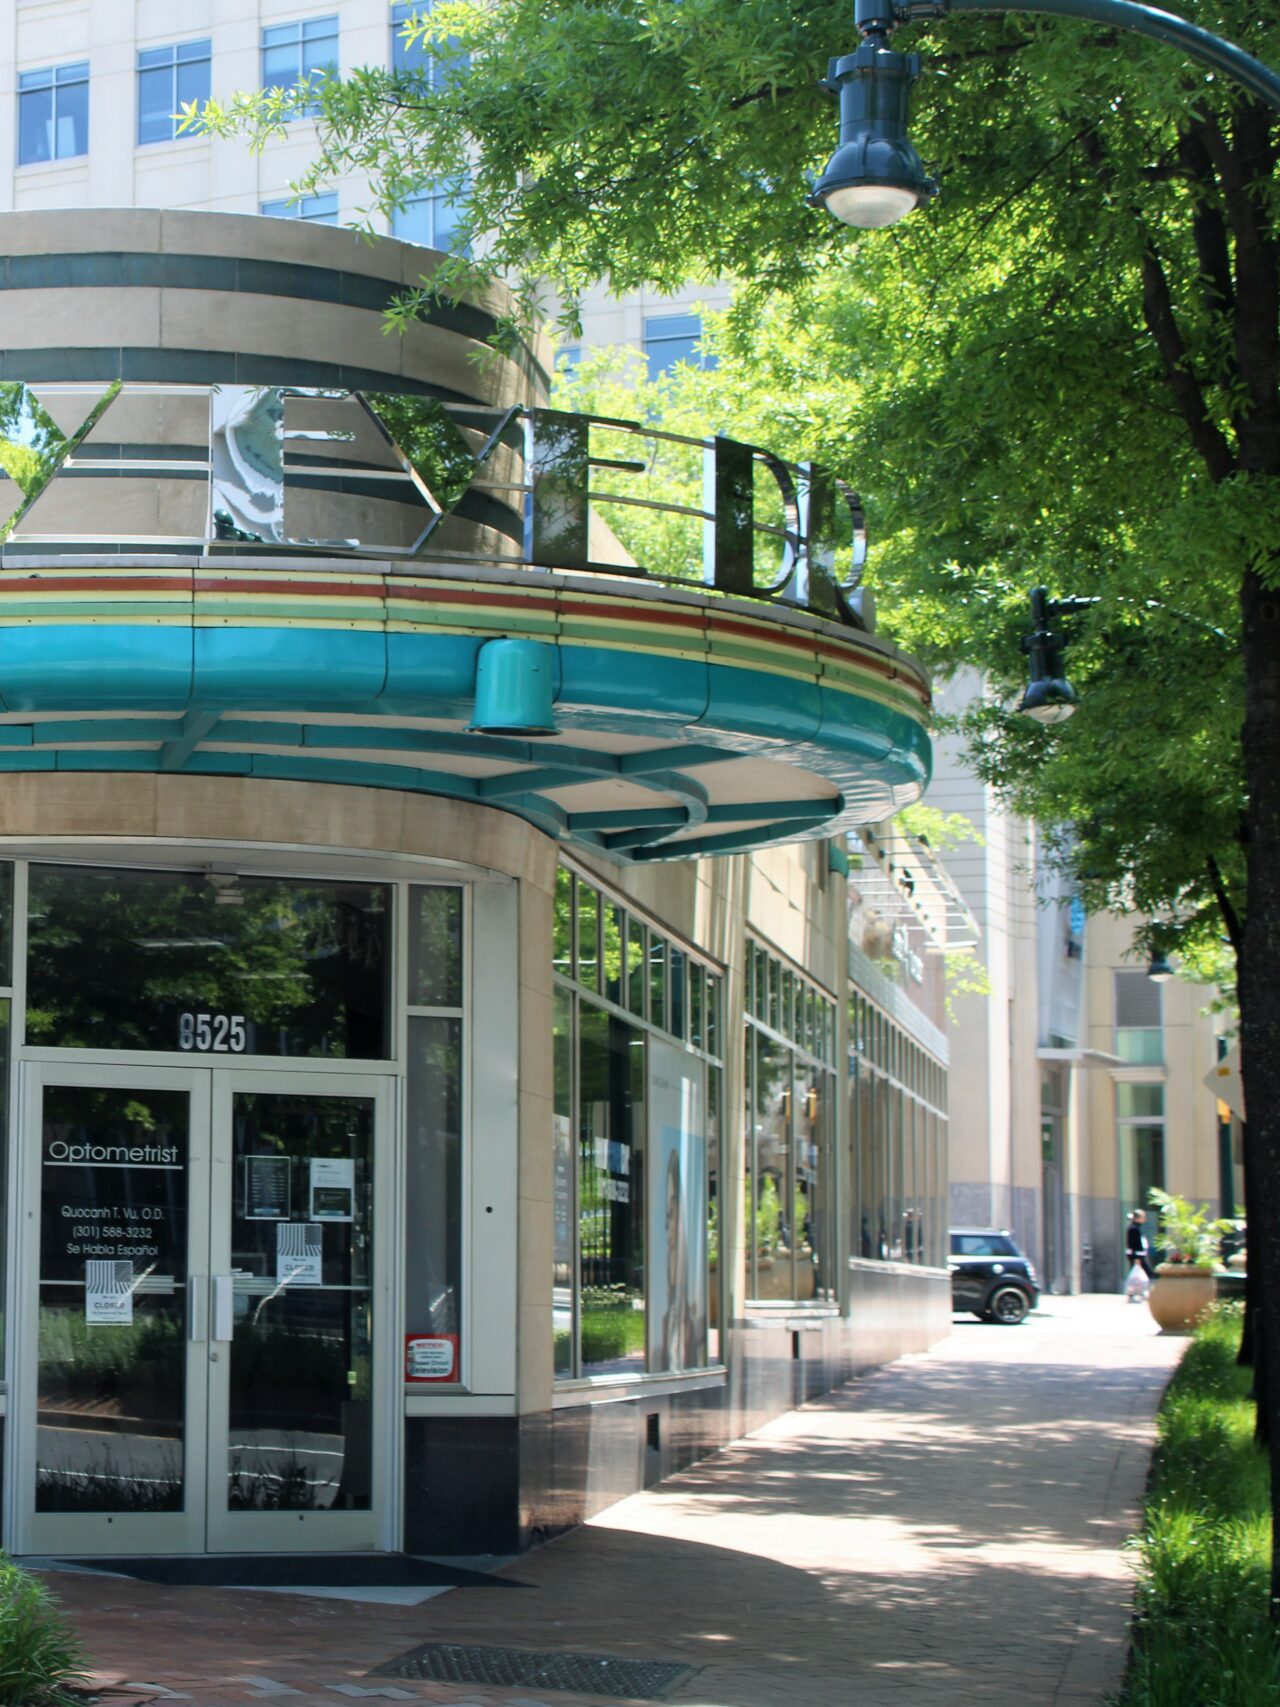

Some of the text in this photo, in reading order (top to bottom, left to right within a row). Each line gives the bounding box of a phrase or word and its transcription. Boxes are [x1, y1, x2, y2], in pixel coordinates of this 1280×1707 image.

[179, 1013, 246, 1052] 8525
[49, 1141, 178, 1163] Optometrist
[61, 1205, 111, 1218] Quocanh
[73, 1226, 153, 1239] (301) 588-3232
[66, 1243, 159, 1257] Se Habla Español
